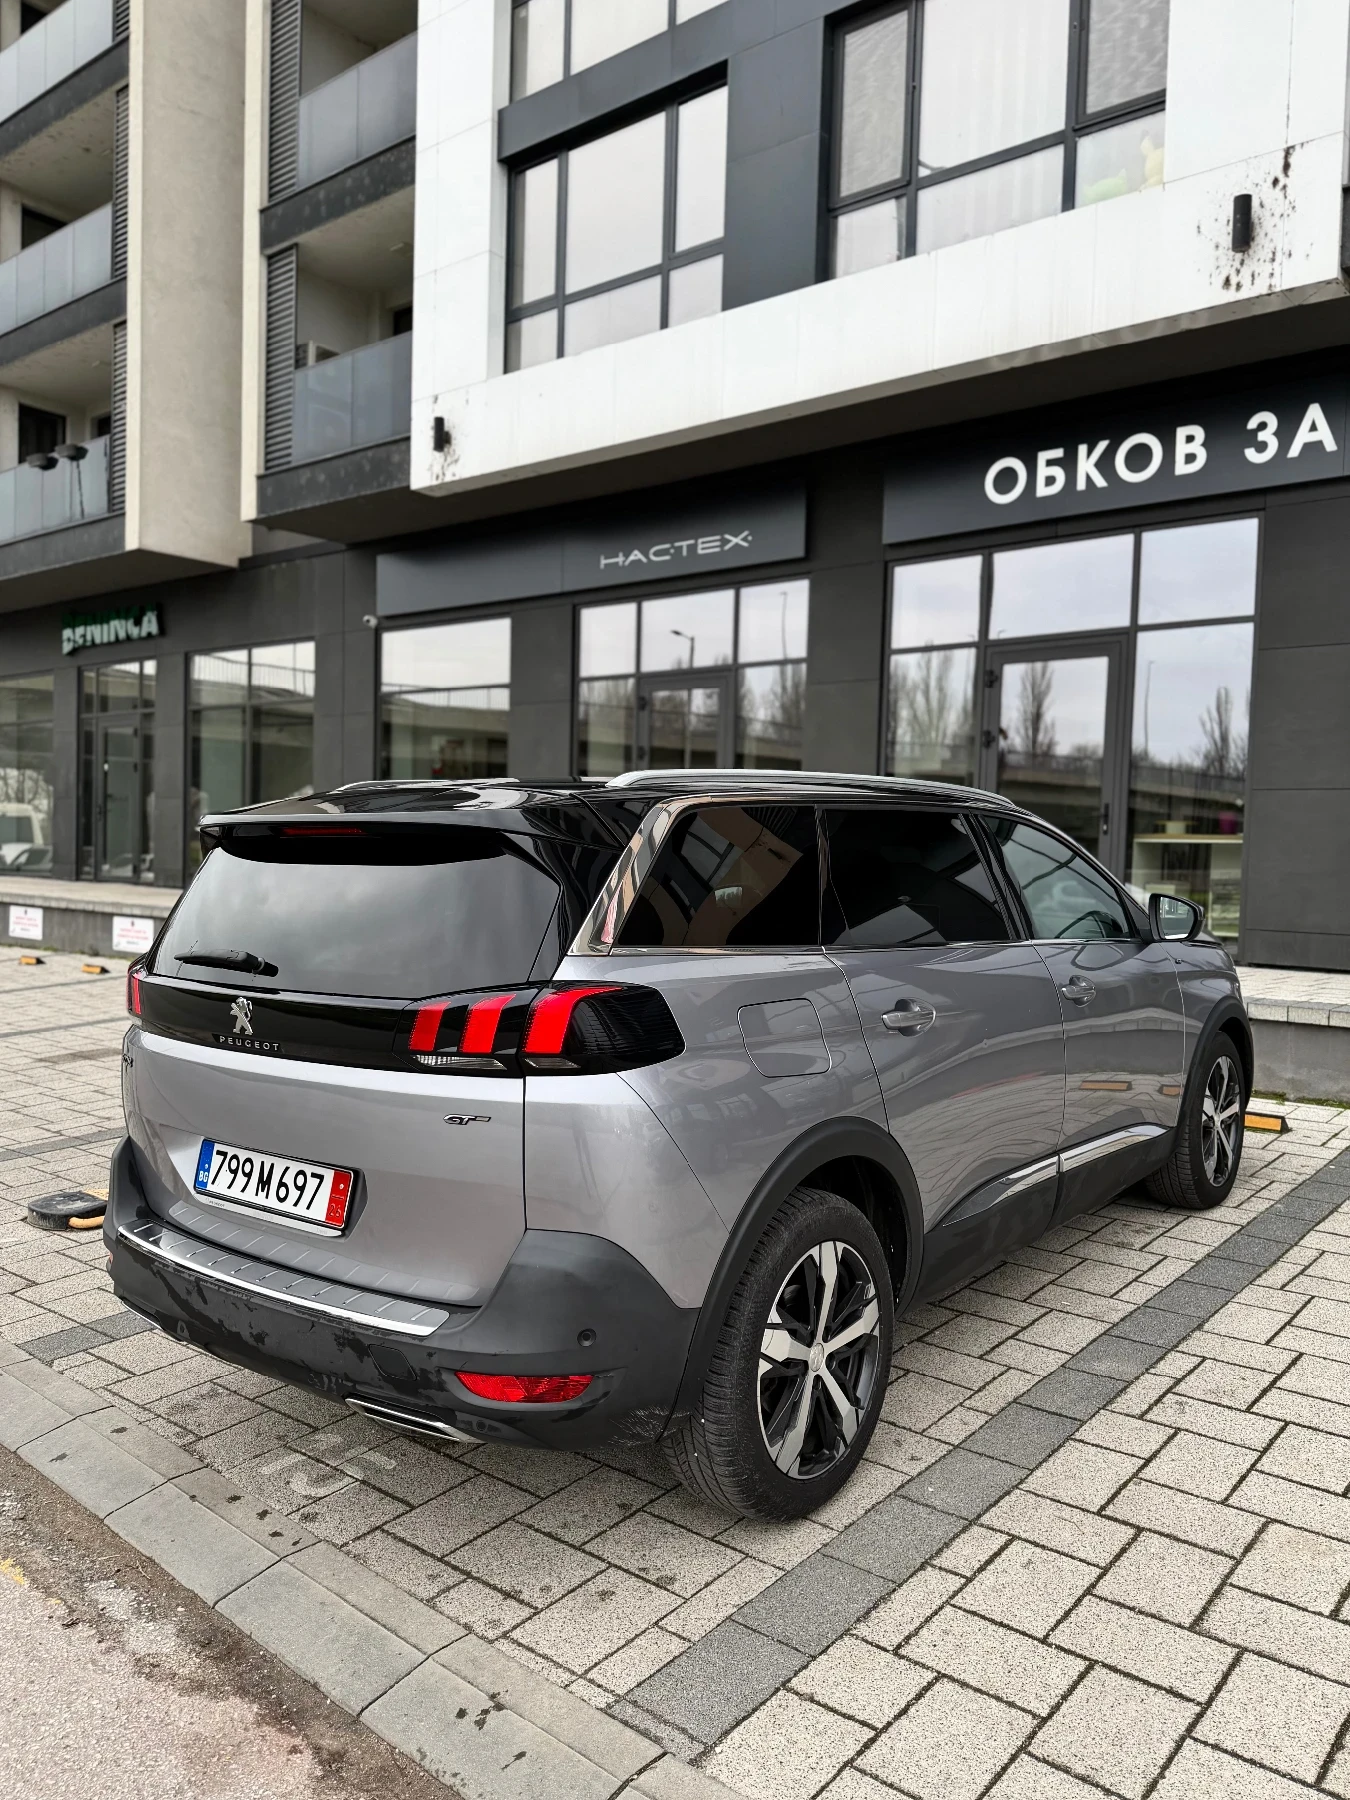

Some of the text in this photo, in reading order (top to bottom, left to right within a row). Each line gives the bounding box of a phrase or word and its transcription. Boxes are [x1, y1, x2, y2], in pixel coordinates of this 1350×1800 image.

[984, 402, 1338, 505] ОБКОВ ЗА
[219, 1035, 279, 1051] PEUGEOT
[198, 1171, 209, 1183] BG
[210, 1149, 325, 1211] 799M697
[328, 1204, 342, 1218] 26
